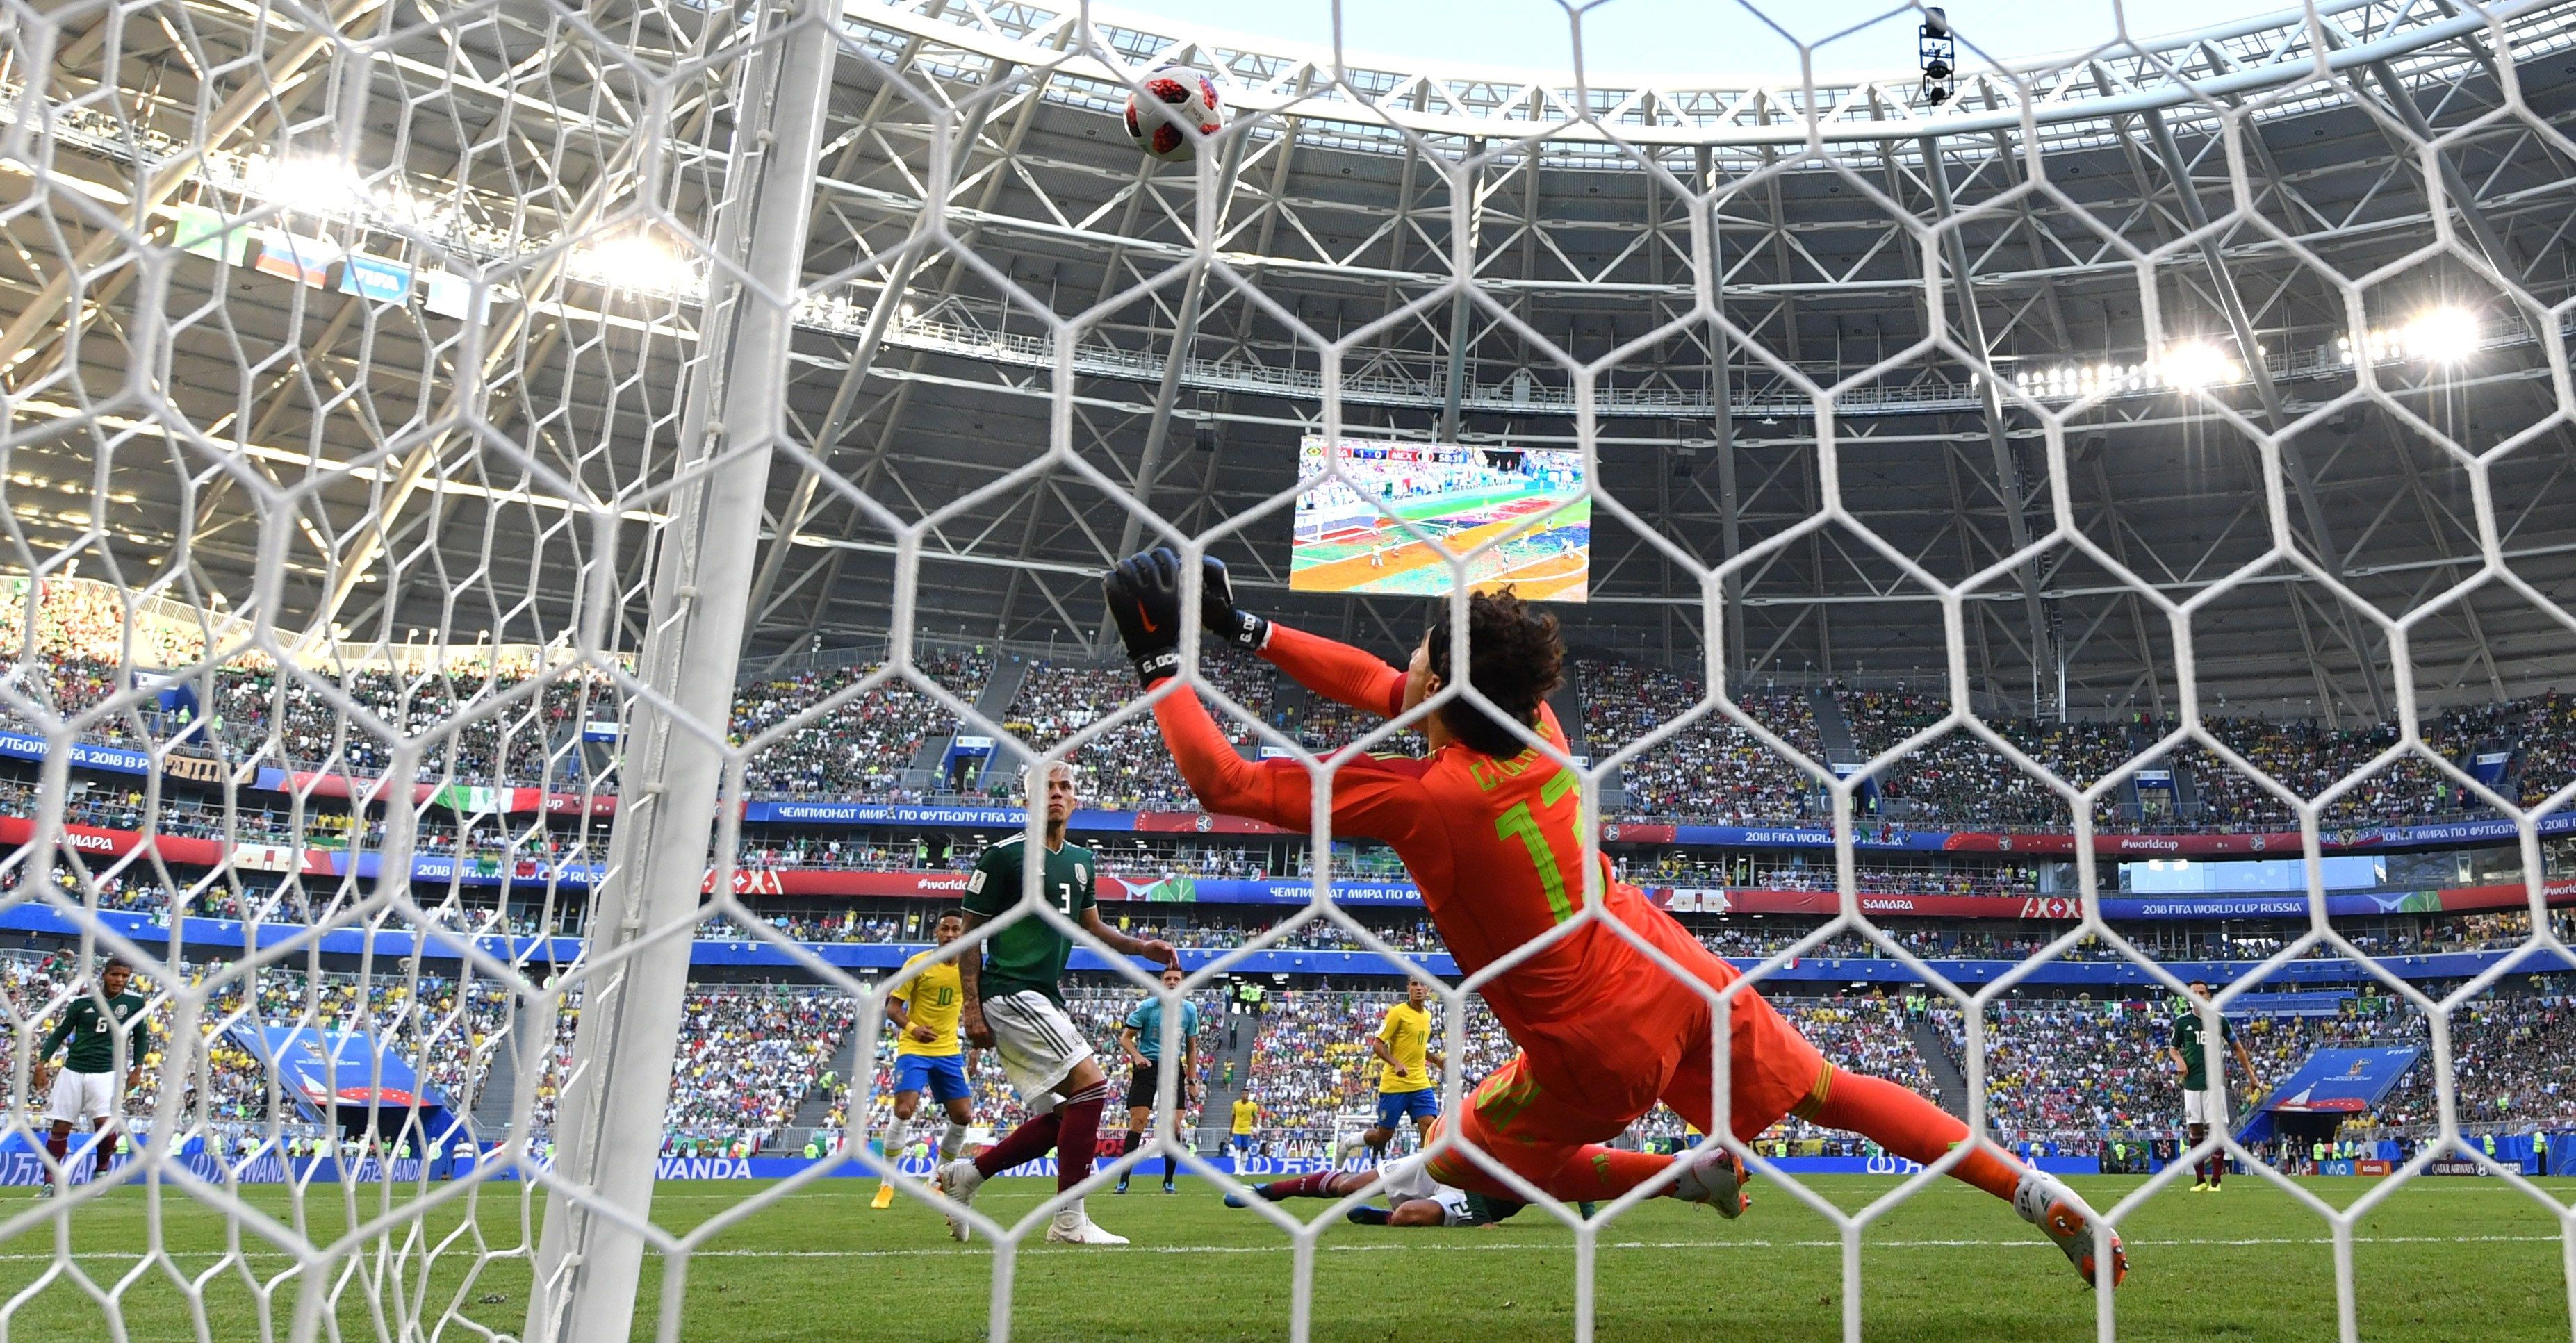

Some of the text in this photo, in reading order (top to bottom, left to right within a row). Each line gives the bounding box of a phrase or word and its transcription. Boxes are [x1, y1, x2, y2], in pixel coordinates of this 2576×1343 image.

[1359, 450, 1364, 459] 1
[1391, 452, 1413, 461] MEX
[1142, 661, 1156, 673] G.
[88, 751, 122, 766] 2018
[779, 806, 857, 819] ЧЕМПИОНАТ
[899, 810, 917, 821] ПО
[920, 811, 978, 823] ФУТБОЛУ
[981, 812, 1006, 823] FIFA
[2416, 827, 2450, 839] МИРА
[2451, 827, 2467, 837] ПО
[2470, 823, 2519, 836] ФУТБОЛУ
[2545, 818, 2569, 830] 2018
[1745, 832, 1770, 842] 2018
[1772, 832, 1795, 843] FIFA
[2121, 836, 2179, 852] #worldcup
[418, 864, 450, 877] 2018
[917, 878, 968, 890] #worldc
[1059, 882, 1070, 914] 3
[1270, 887, 1344, 899] ЧЕМПИАТ
[1347, 889, 1383, 899] МИРА
[1386, 889, 1403, 900] ПО
[1862, 898, 1914, 910] SAMARA
[2142, 902, 2302, 914] 2018 FIFA WORLD CUP RUSSIA
[937, 987, 953, 1005] 10
[95, 1016, 108, 1032] 6
[1418, 1030, 1425, 1046] 11
